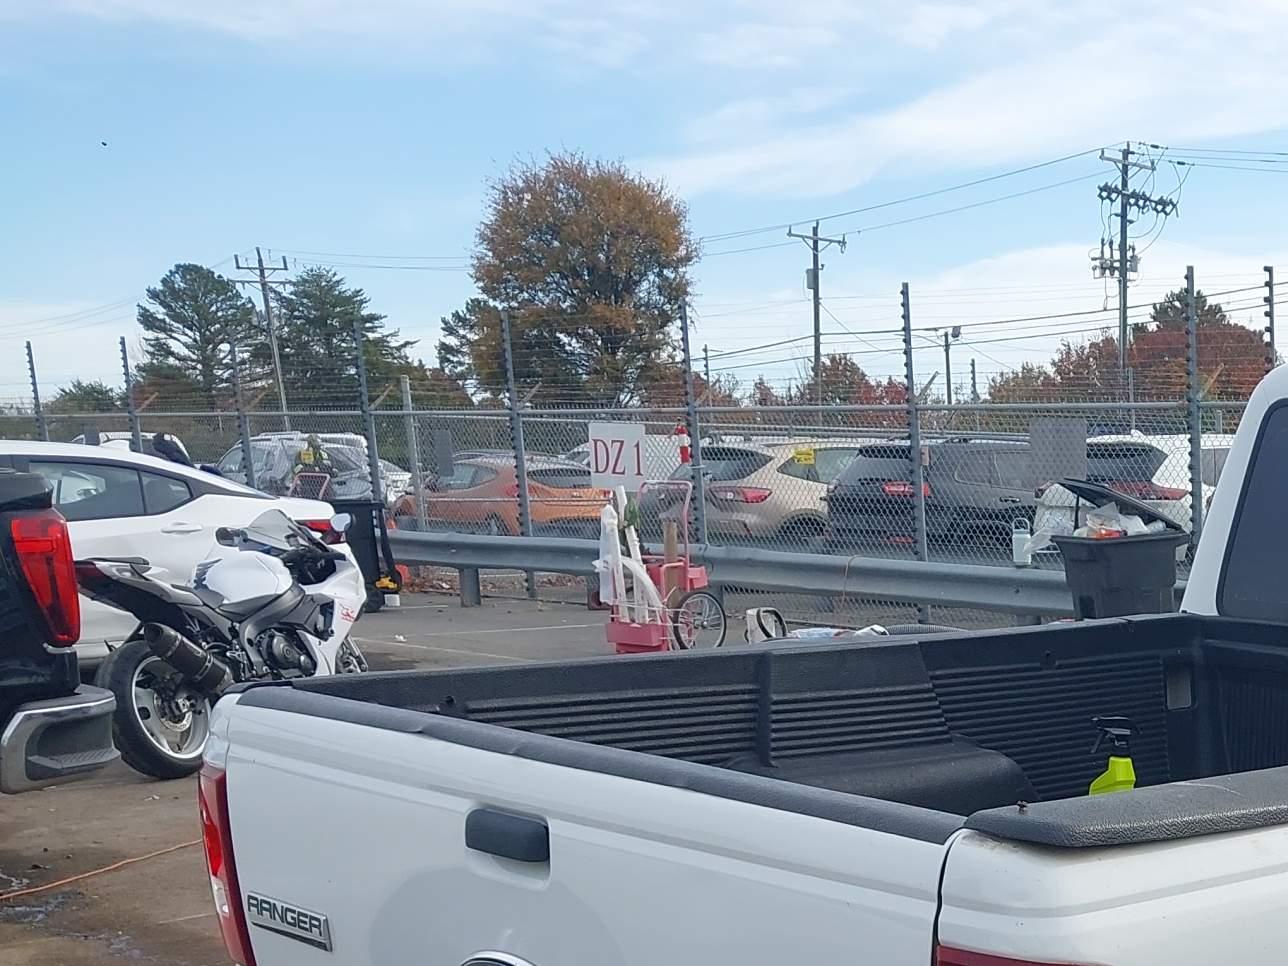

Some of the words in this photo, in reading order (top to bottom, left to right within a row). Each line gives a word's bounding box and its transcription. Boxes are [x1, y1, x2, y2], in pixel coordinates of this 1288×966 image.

[591, 438, 626, 475] DZ
[632, 439, 645, 477] 1
[246, 894, 323, 937] RANGER
